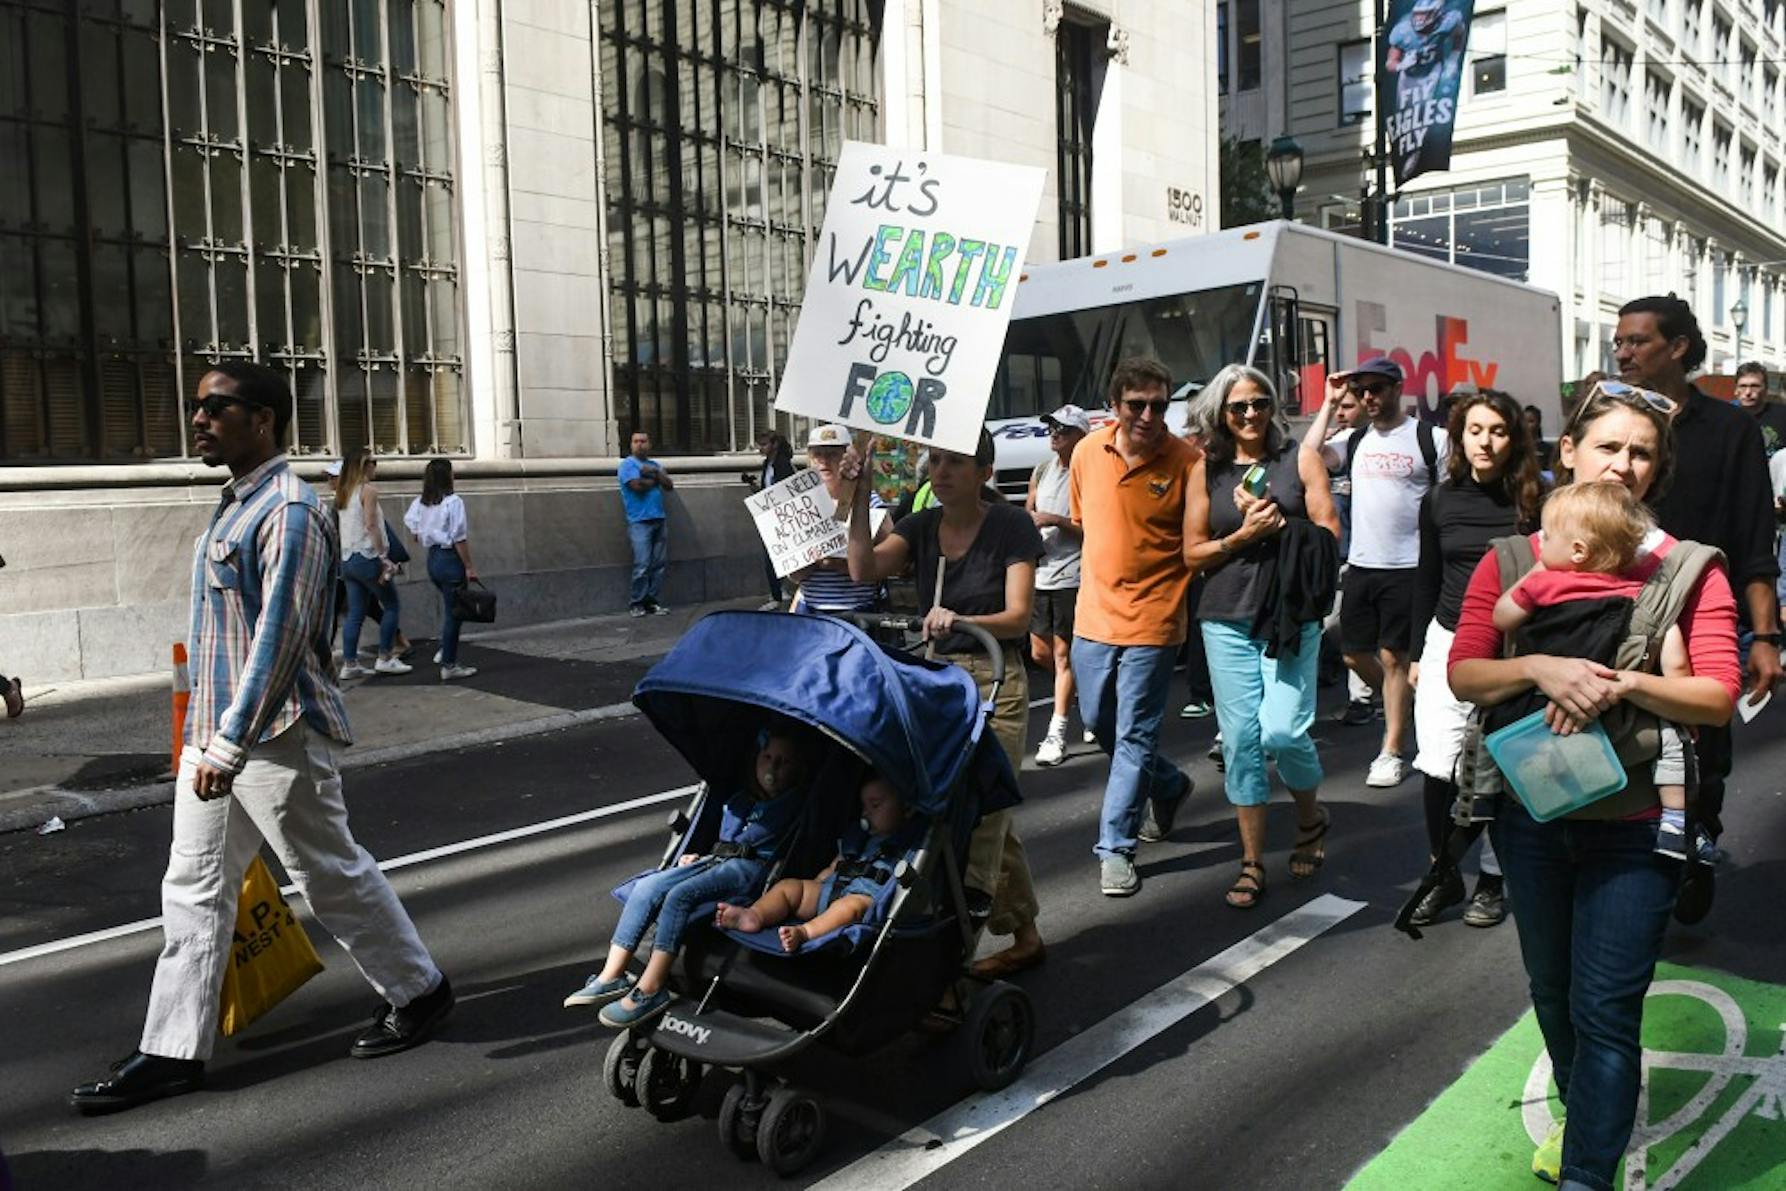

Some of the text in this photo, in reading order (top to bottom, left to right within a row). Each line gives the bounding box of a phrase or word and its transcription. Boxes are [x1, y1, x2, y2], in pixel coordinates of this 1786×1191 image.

[1400, 80, 1436, 110] FLY
[1386, 97, 1453, 143] EAGLES
[1399, 127, 1428, 156] FLY
[850, 161, 940, 216] it's
[1168, 186, 1202, 214] 1500
[1169, 210, 1202, 228] WALNUT
[838, 298, 957, 376] fighting
[838, 362, 947, 440] FOR
[753, 471, 820, 511] WE NEED
[774, 495, 812, 523] BOLD
[774, 505, 822, 539] ACTION
[771, 540, 788, 555] ON
[656, 1011, 711, 1045] joovy
